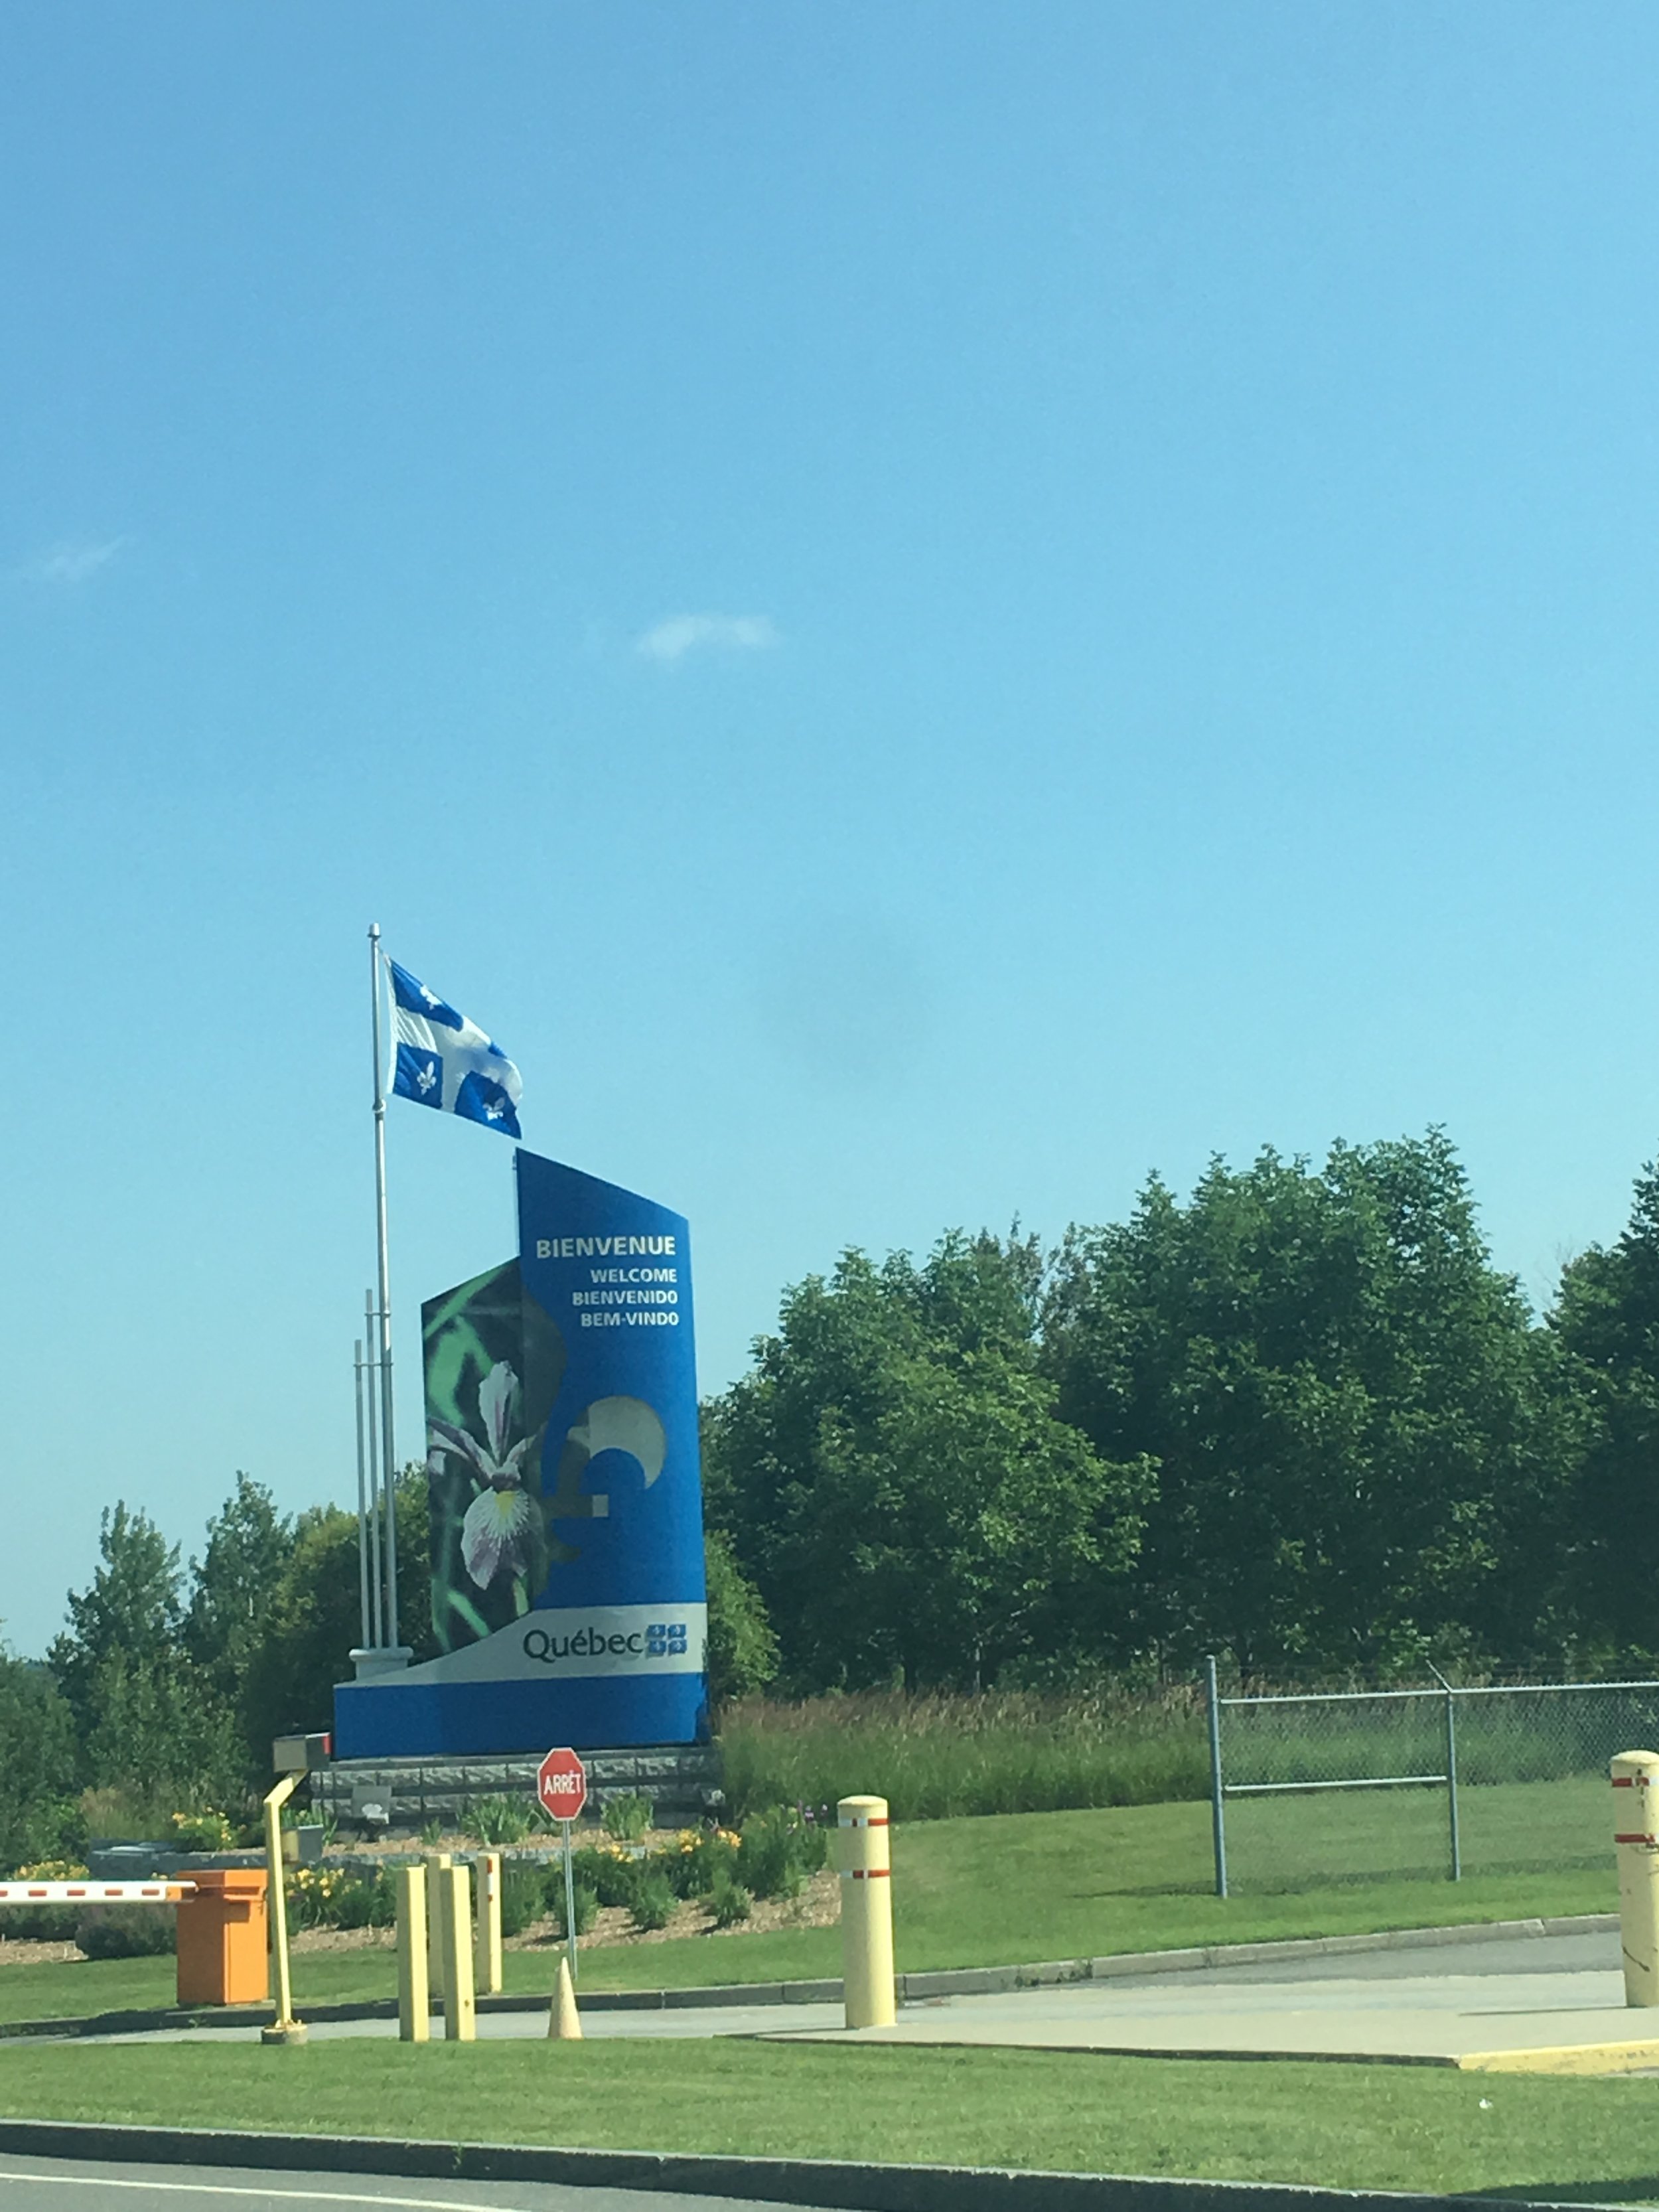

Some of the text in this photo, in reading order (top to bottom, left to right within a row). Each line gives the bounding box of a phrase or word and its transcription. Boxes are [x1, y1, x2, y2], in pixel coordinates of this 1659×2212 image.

[536, 1236, 676, 1258] BIENVENUE
[590, 1268, 678, 1283] WELCOME
[572, 1290, 678, 1306] BIENVENIDO
[581, 1311, 680, 1327] BEM-VINDO
[523, 1627, 643, 1663] Québec
[544, 1769, 581, 1795] ARRÊT
